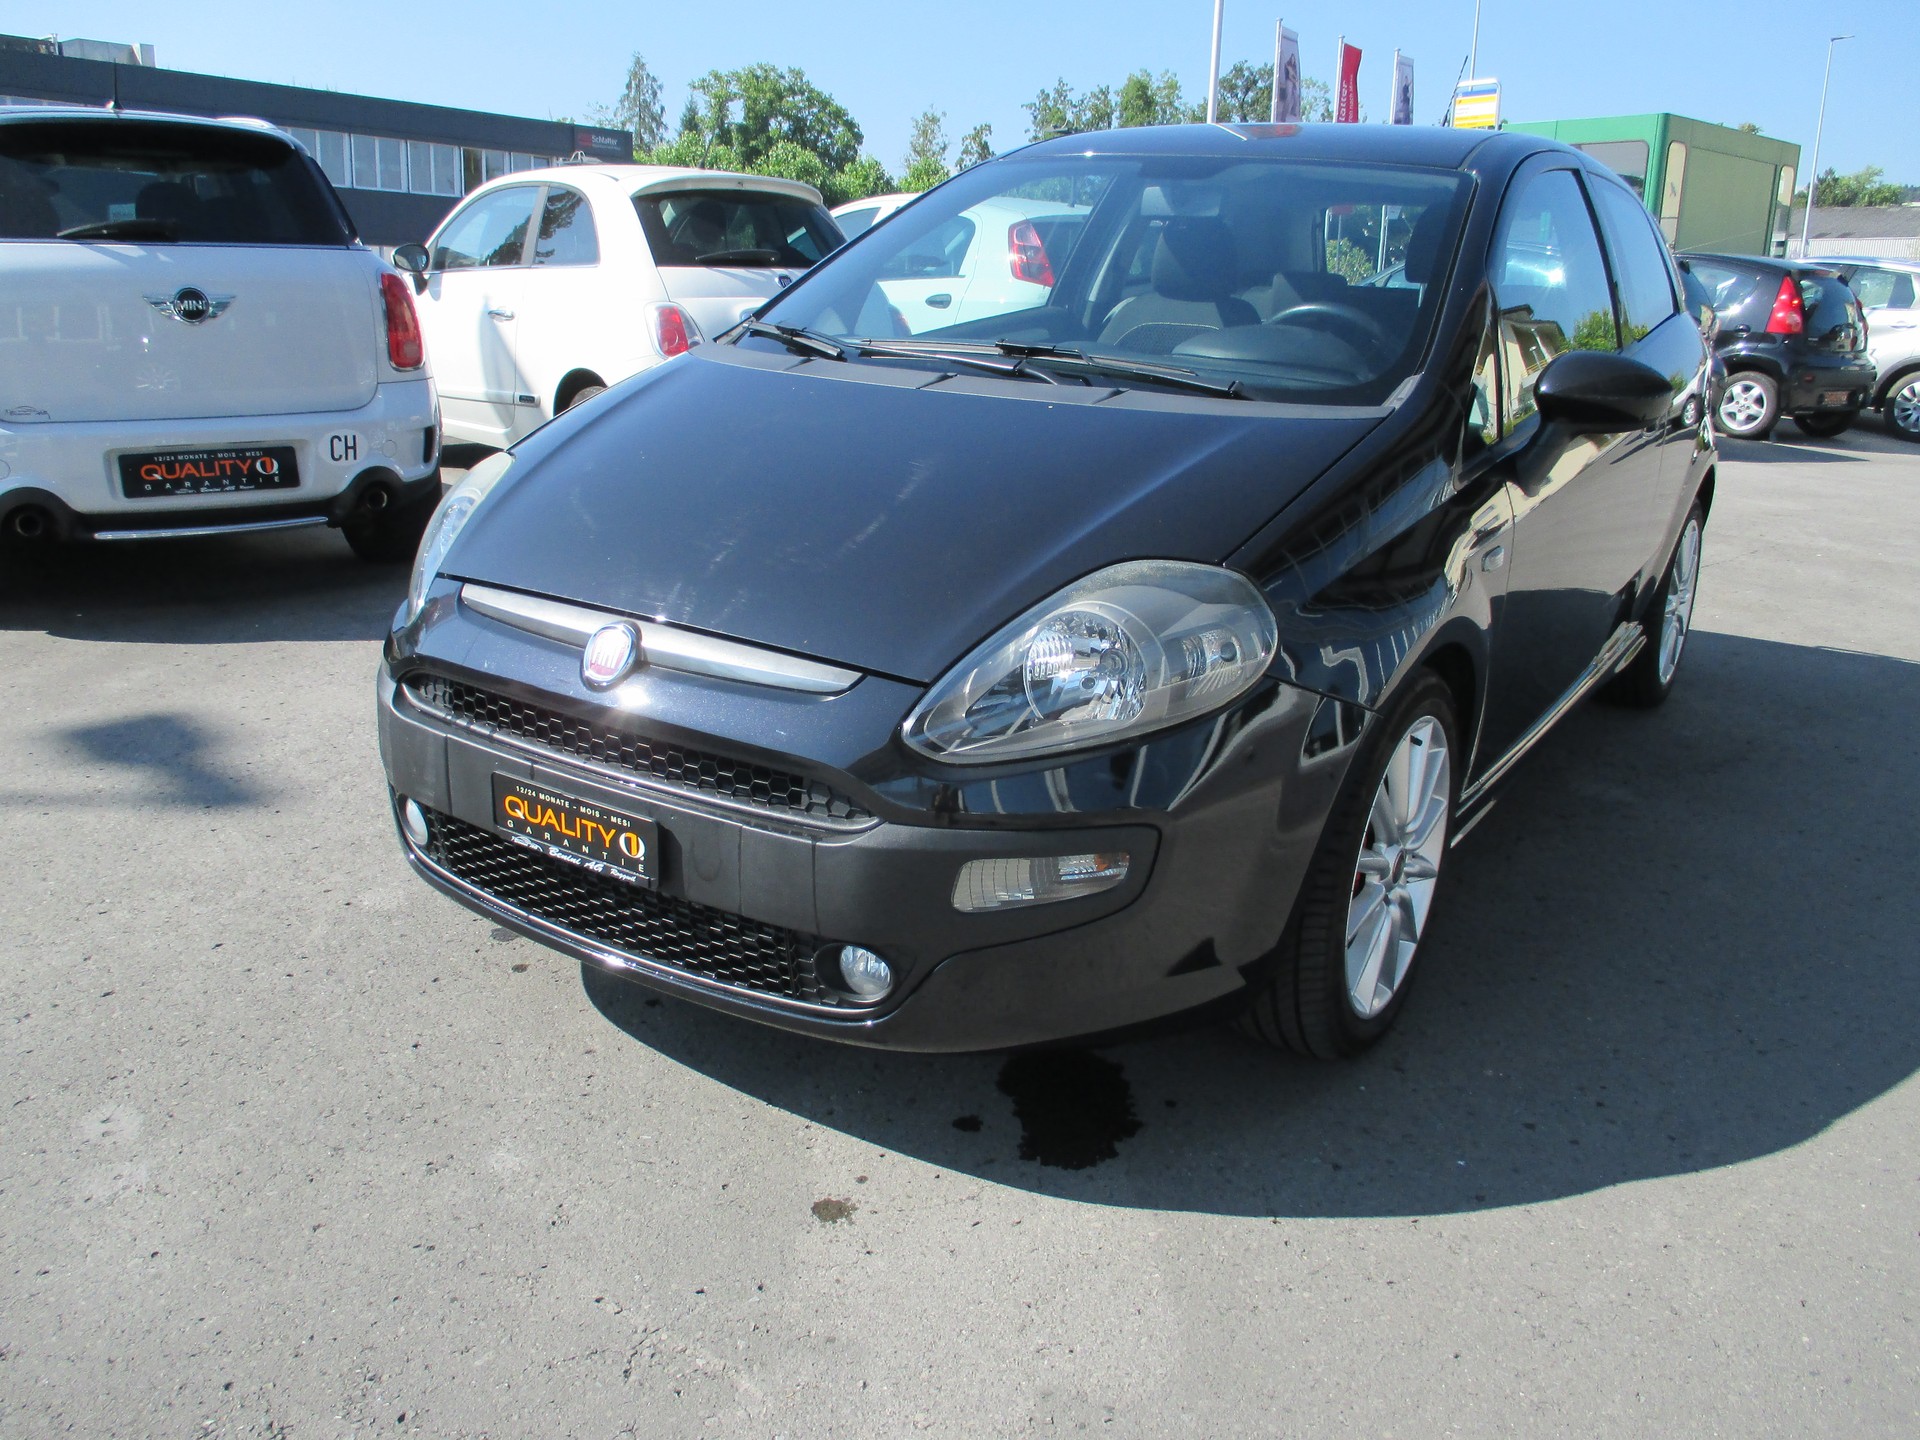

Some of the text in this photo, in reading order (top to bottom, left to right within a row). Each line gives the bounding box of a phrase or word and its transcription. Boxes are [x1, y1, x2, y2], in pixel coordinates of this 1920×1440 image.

[591, 135, 617, 145] Schlatter
[177, 300, 206, 310] MINI
[330, 435, 357, 461] CH
[140, 459, 252, 481] QUALITY
[516, 785, 536, 798] 12/24
[539, 792, 570, 809] MONATE
[580, 806, 600, 819] MOIS
[611, 815, 631, 828] MESI
[504, 795, 617, 848] QUALITY
